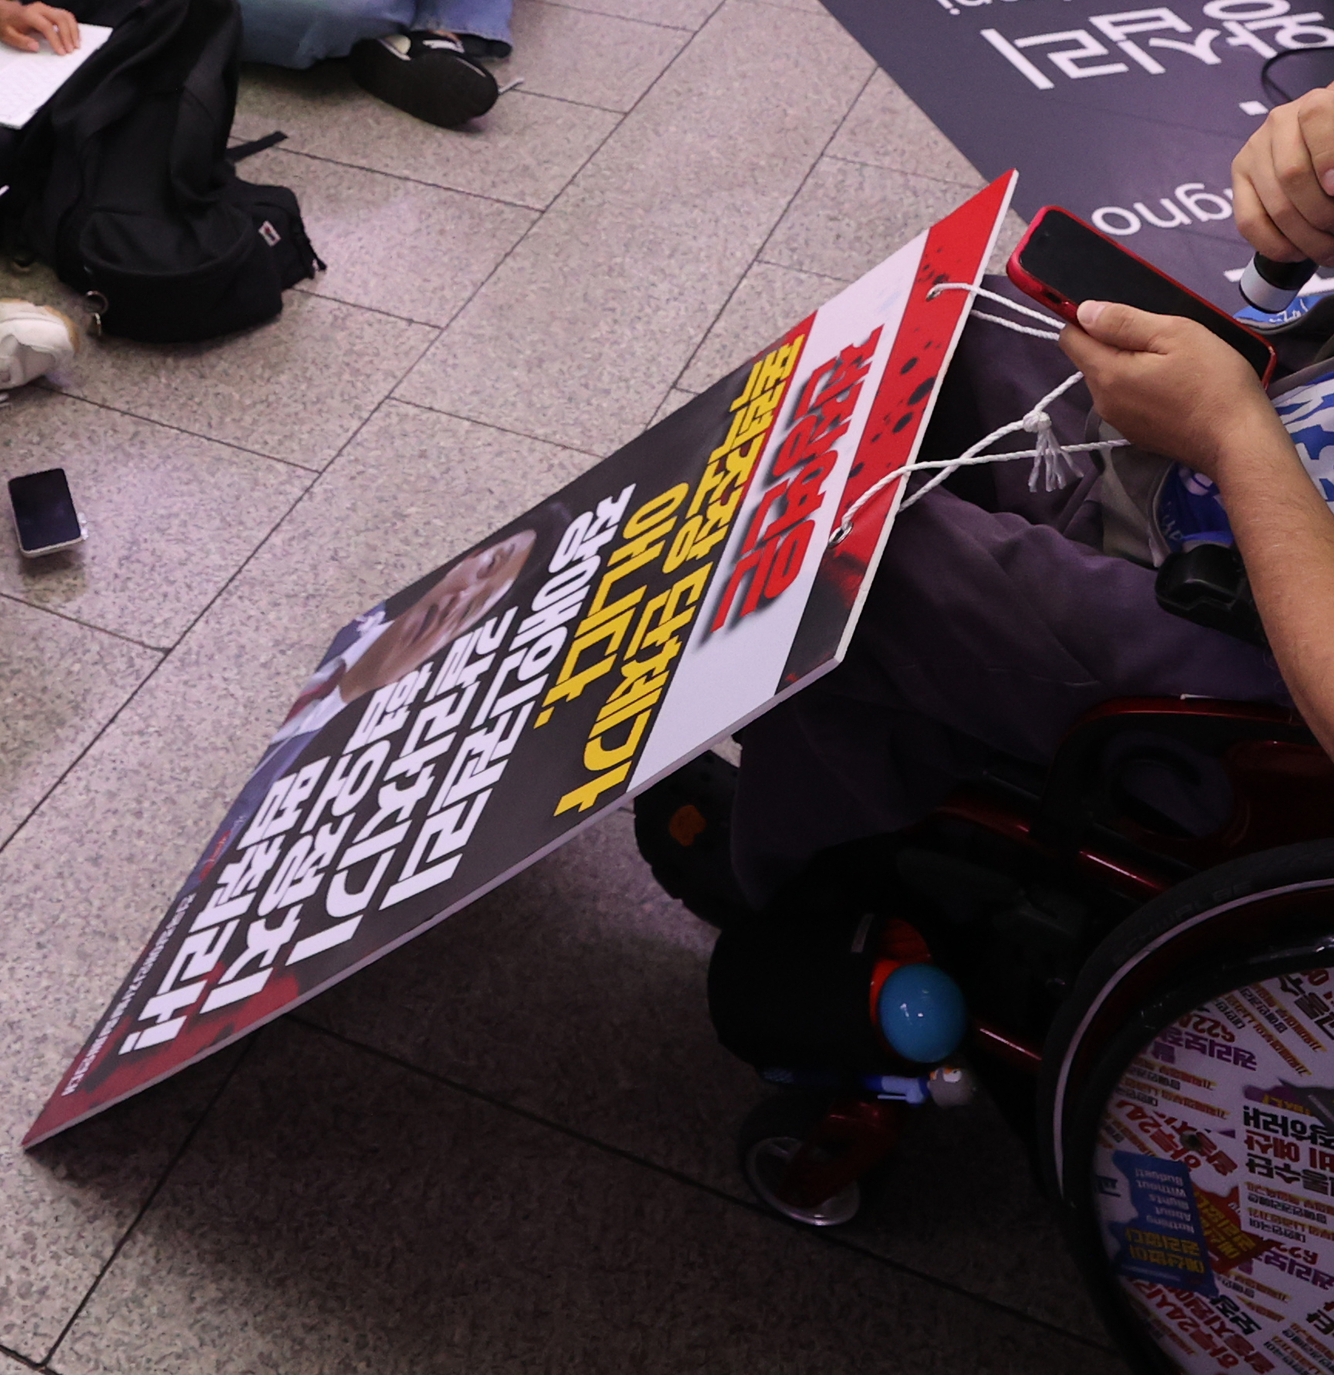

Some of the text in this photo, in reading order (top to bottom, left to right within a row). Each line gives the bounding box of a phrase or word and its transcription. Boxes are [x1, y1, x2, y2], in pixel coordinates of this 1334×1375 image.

[534, 482, 689, 728] 아니다.
[553, 333, 805, 817] 폭력조장 단체가
[710, 323, 885, 634] 전장연은
[199, 662, 433, 1014] 혐오정치
[285, 606, 519, 967] 갈라치기
[378, 482, 636, 911] 장애인권리
[118, 756, 330, 1056] 멈춰라!
[1135, 1179, 1187, 1198] Without
[1154, 1207, 1191, 1222] About
[1244, 1130, 1300, 1162] 예산
